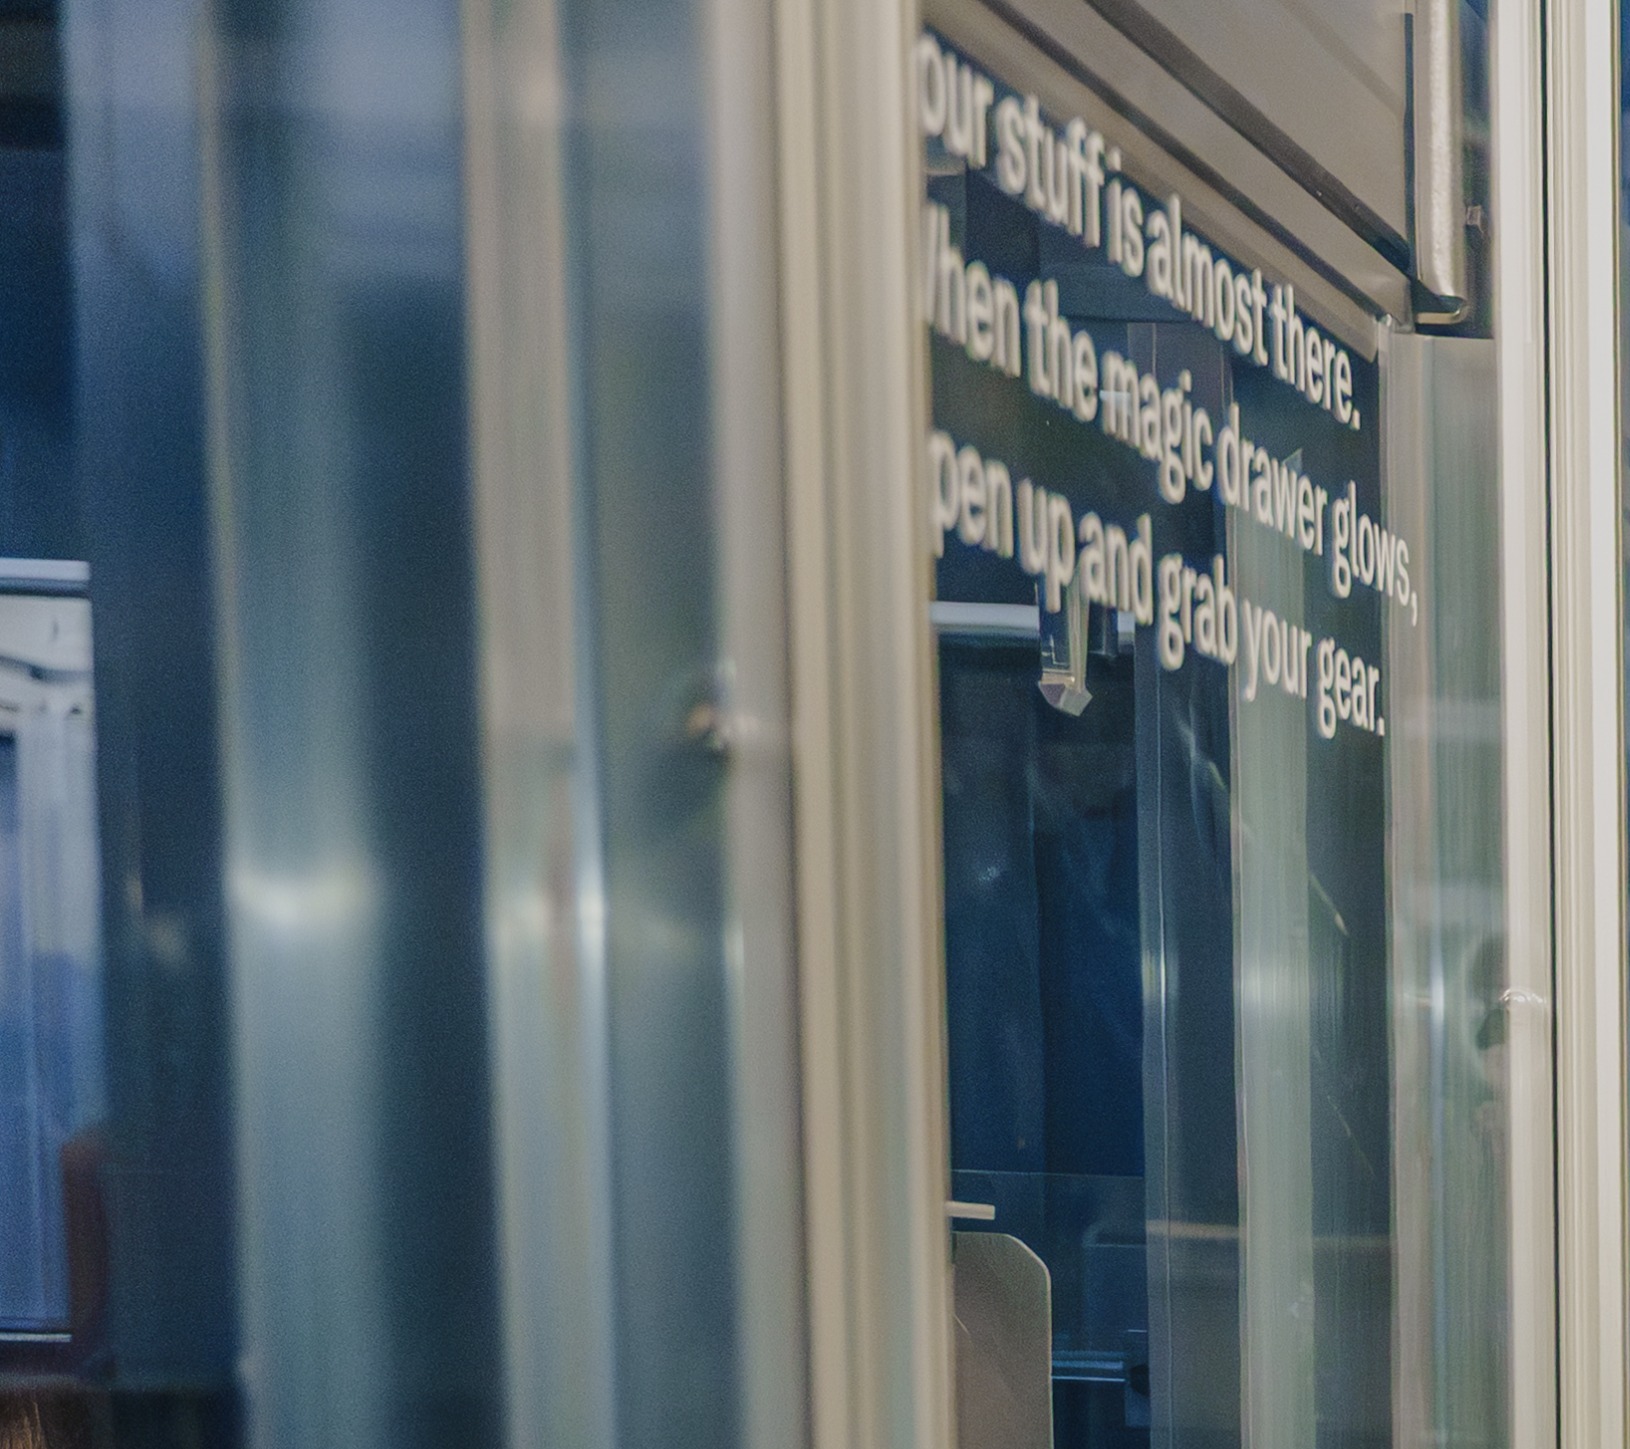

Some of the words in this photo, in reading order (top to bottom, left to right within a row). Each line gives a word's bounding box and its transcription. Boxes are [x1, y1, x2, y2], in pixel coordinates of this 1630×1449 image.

[919, 33, 994, 169] our
[996, 95, 1105, 248] stuff
[1106, 146, 1145, 277] is
[1147, 194, 1268, 367] almost
[1269, 283, 1361, 431] there.
[924, 200, 1022, 379] hen
[1023, 278, 1098, 422] the
[1101, 349, 1214, 504] magic
[1216, 402, 1327, 556] drawer
[1332, 480, 1418, 628] glows,
[928, 430, 1014, 559] pen
[1016, 478, 1076, 614] up
[1078, 511, 1154, 626] and
[1157, 552, 1238, 672] grab
[1242, 598, 1312, 702] your
[1316, 636, 1386, 740] gear.
